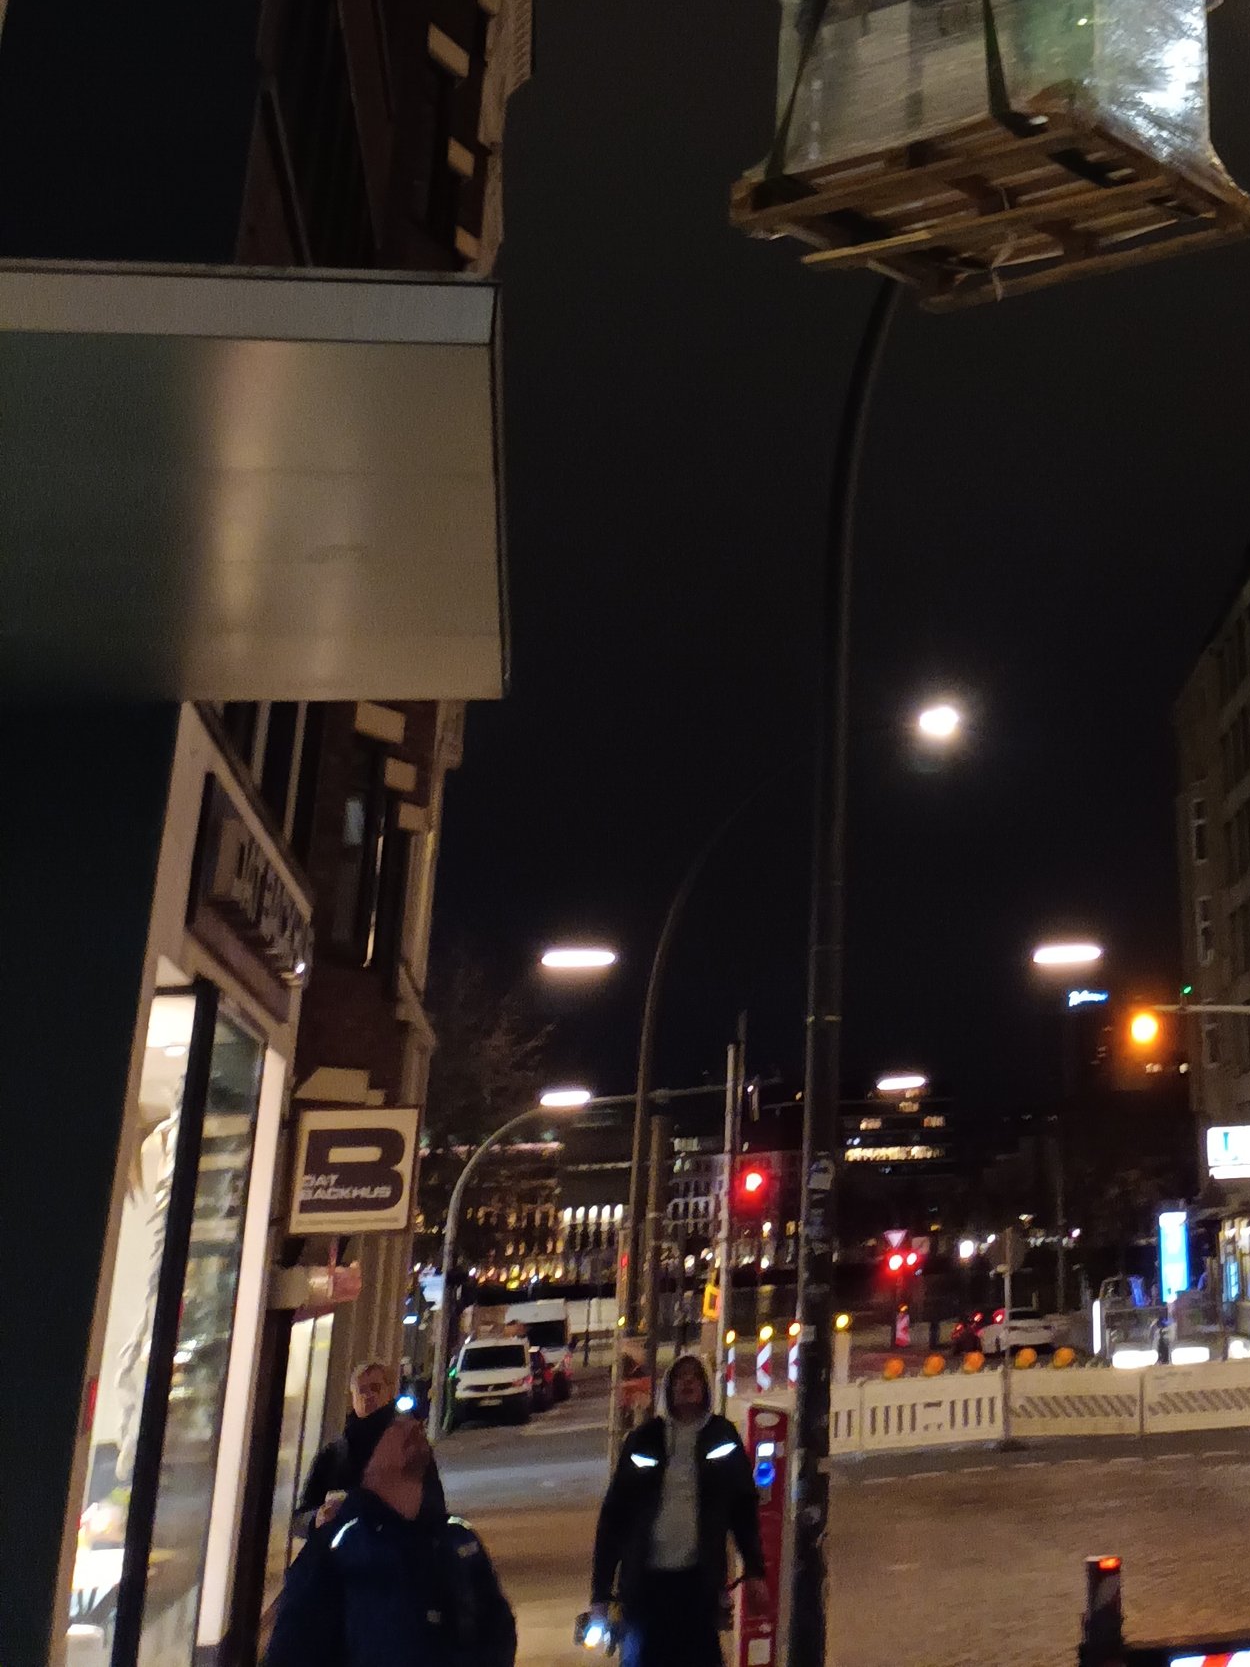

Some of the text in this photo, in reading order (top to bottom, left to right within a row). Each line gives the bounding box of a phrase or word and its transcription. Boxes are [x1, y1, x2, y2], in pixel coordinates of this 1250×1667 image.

[299, 1128, 405, 1214] B
[301, 1174, 340, 1188] DAT
[299, 1185, 392, 1201] BACKHUS
